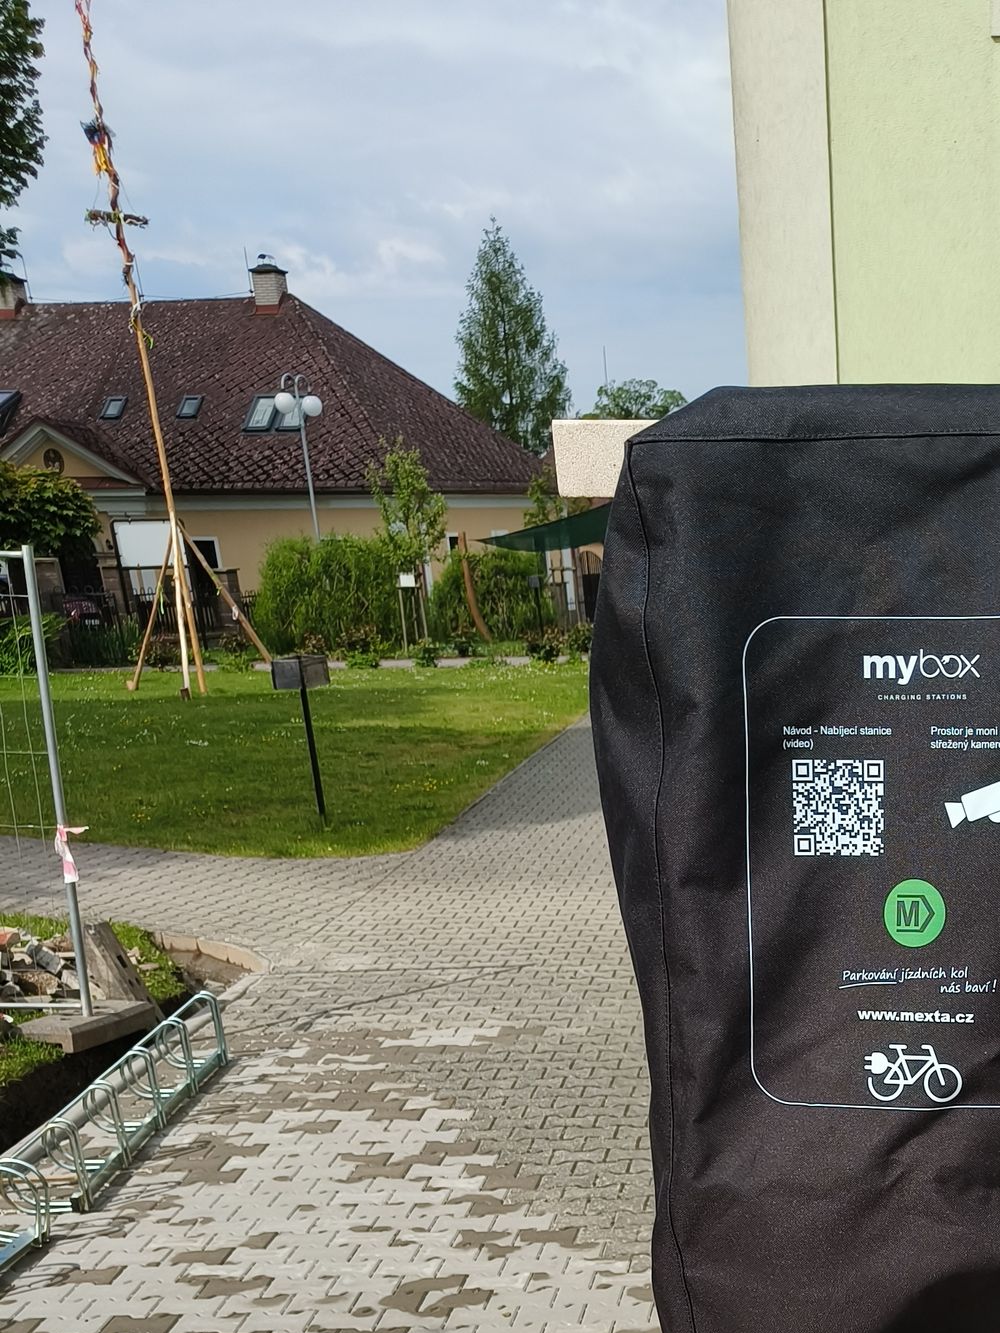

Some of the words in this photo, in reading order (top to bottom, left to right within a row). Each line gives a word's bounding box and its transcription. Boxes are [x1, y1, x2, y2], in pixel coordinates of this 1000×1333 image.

[863, 648, 981, 686] mybox
[782, 725, 812, 735] Návod
[860, 725, 892, 736] stanice
[930, 725, 964, 736] Prostor
[965, 726, 974, 738] je
[782, 738, 814, 750] (video)
[930, 738, 968, 751] střežený
[842, 967, 899, 981] Parkování
[898, 966, 947, 983] jízdních
[950, 965, 969, 979] kol
[940, 980, 961, 993] nás
[857, 1009, 975, 1023] www.mexta.cz
